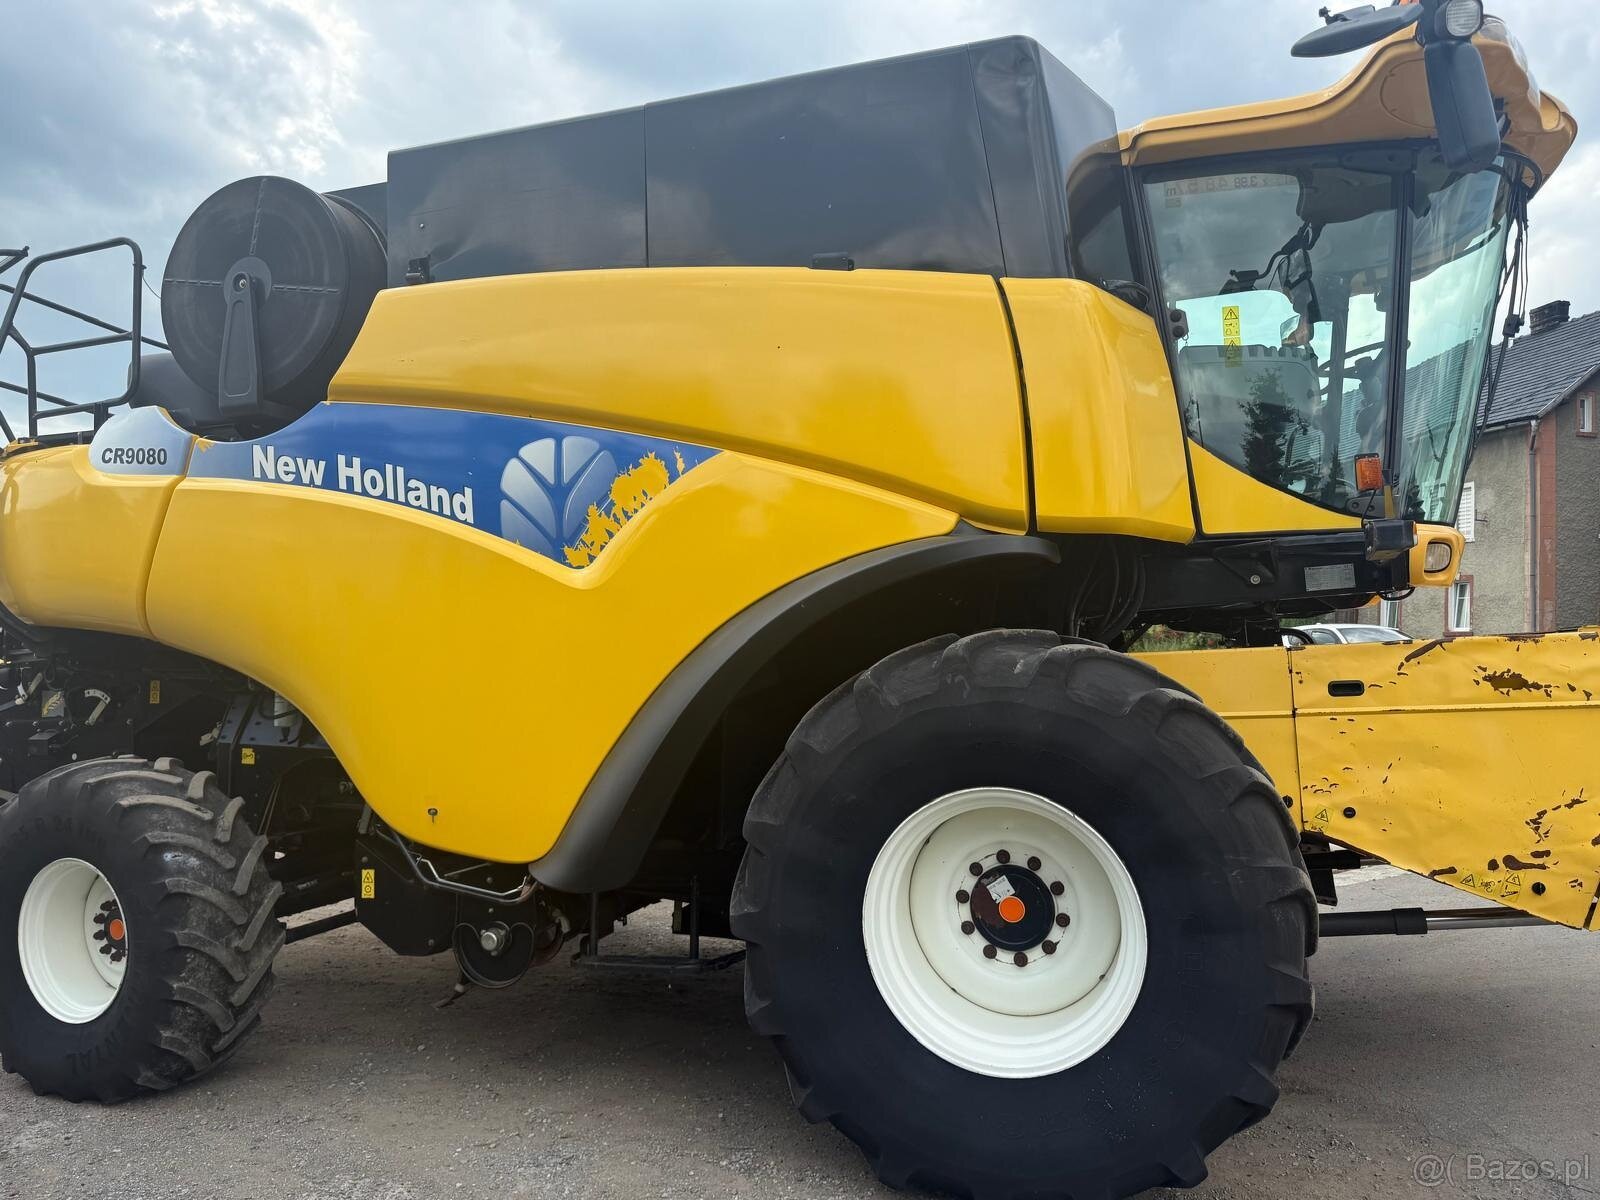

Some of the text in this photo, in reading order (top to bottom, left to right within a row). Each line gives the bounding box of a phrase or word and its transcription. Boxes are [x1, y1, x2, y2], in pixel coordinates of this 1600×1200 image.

[101, 447, 168, 466] CR9080
[251, 444, 475, 525] New Holland
